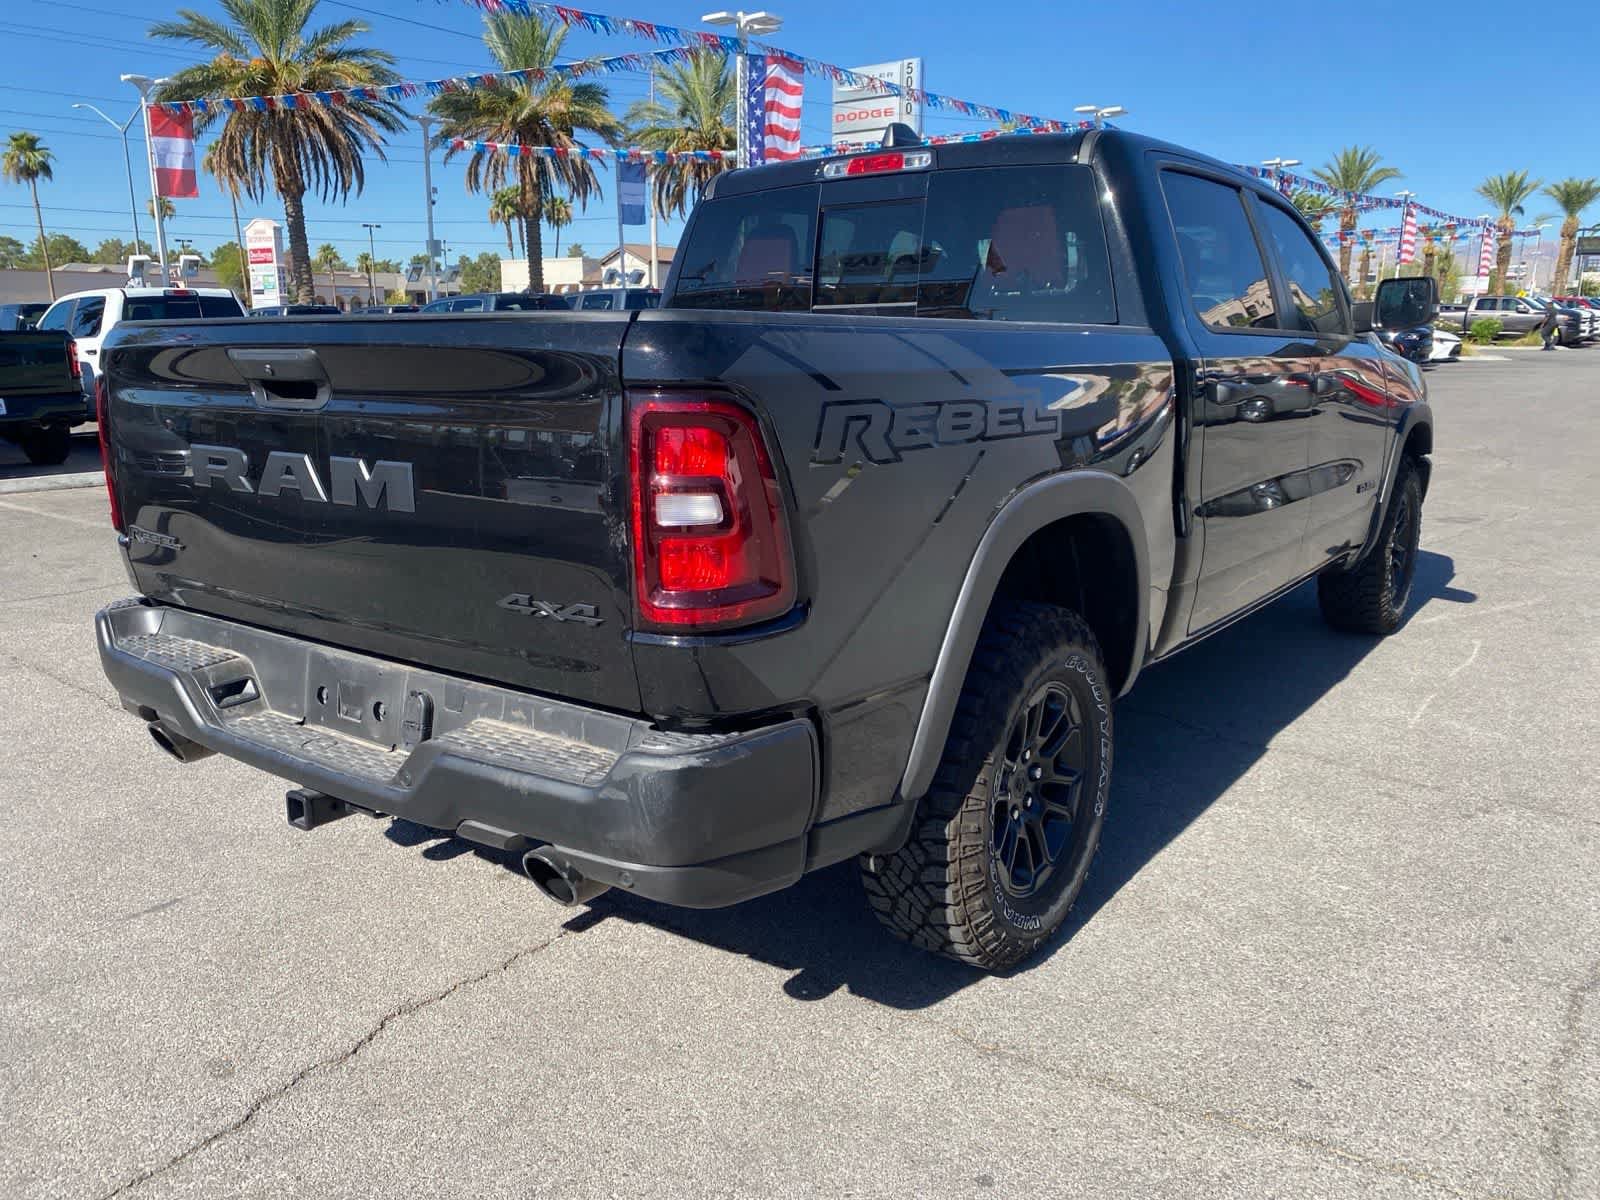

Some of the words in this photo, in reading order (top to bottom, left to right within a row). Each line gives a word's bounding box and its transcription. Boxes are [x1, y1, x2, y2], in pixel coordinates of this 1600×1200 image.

[835, 107, 895, 123] DODGE
[808, 398, 1063, 466] REBEL
[190, 443, 416, 513] RAM
